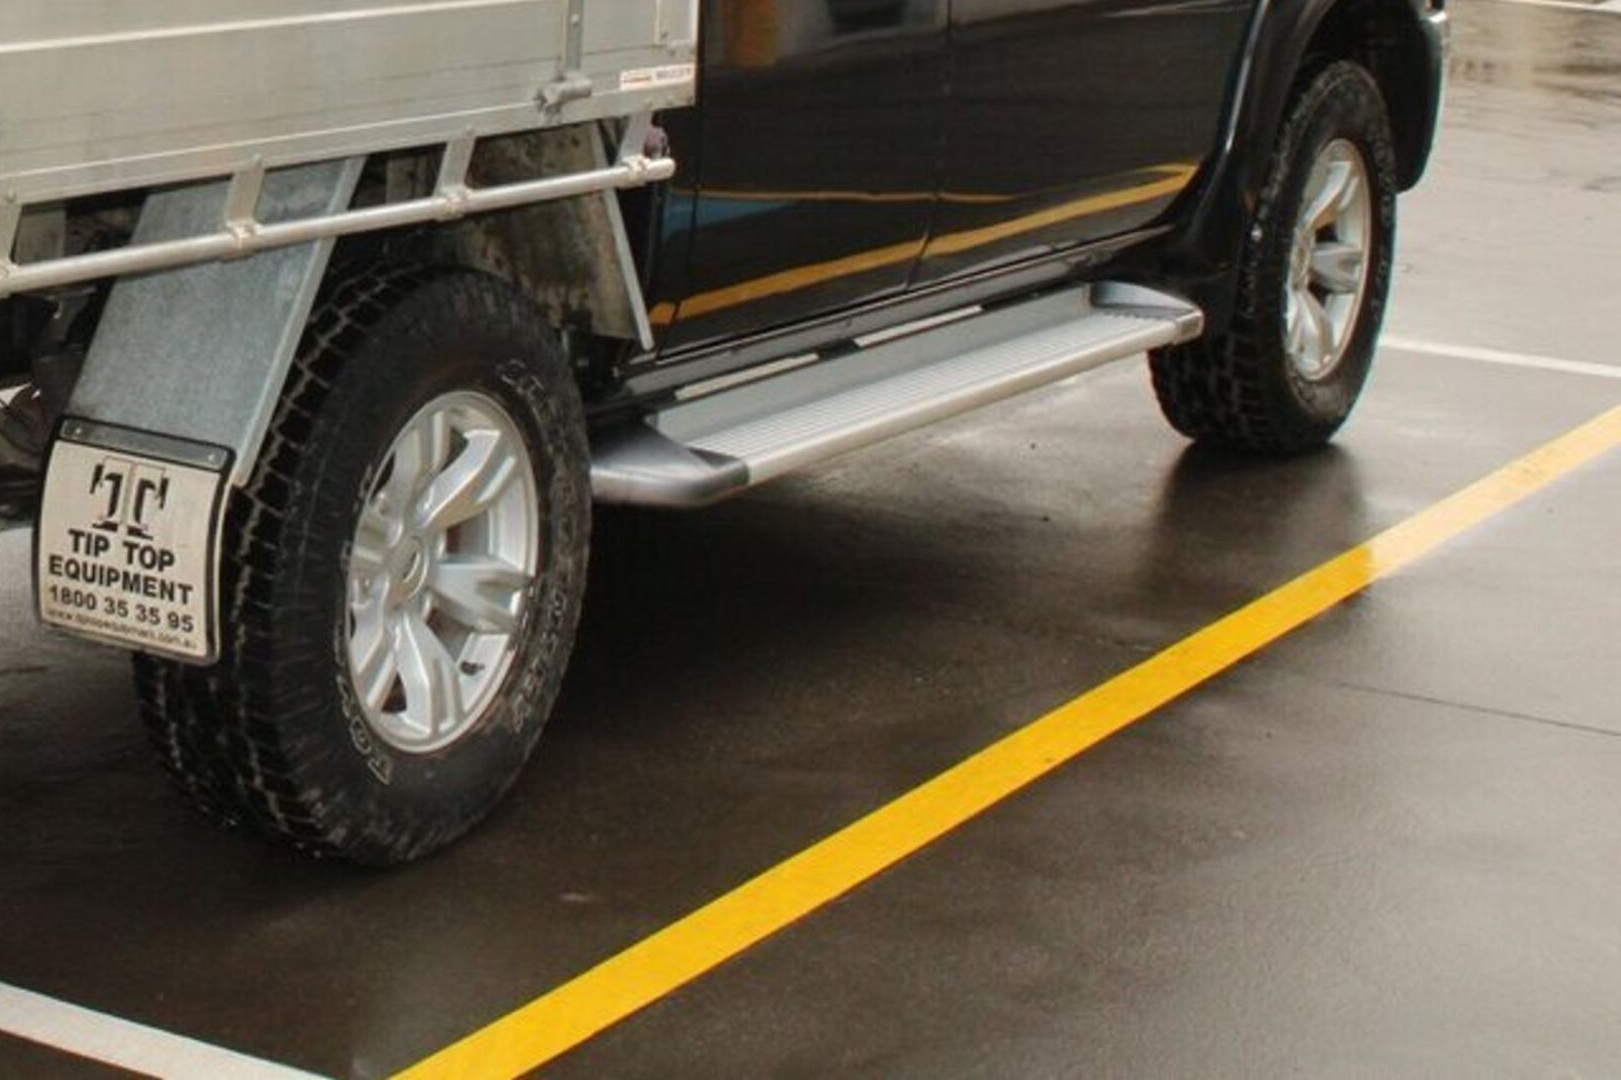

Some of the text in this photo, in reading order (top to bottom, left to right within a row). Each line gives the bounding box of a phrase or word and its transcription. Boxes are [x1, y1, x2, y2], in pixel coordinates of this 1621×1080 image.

[68, 528, 175, 573] TIP TOP
[48, 554, 193, 605] EQUIPMENT
[49, 584, 195, 633] 1800 35 35 95
